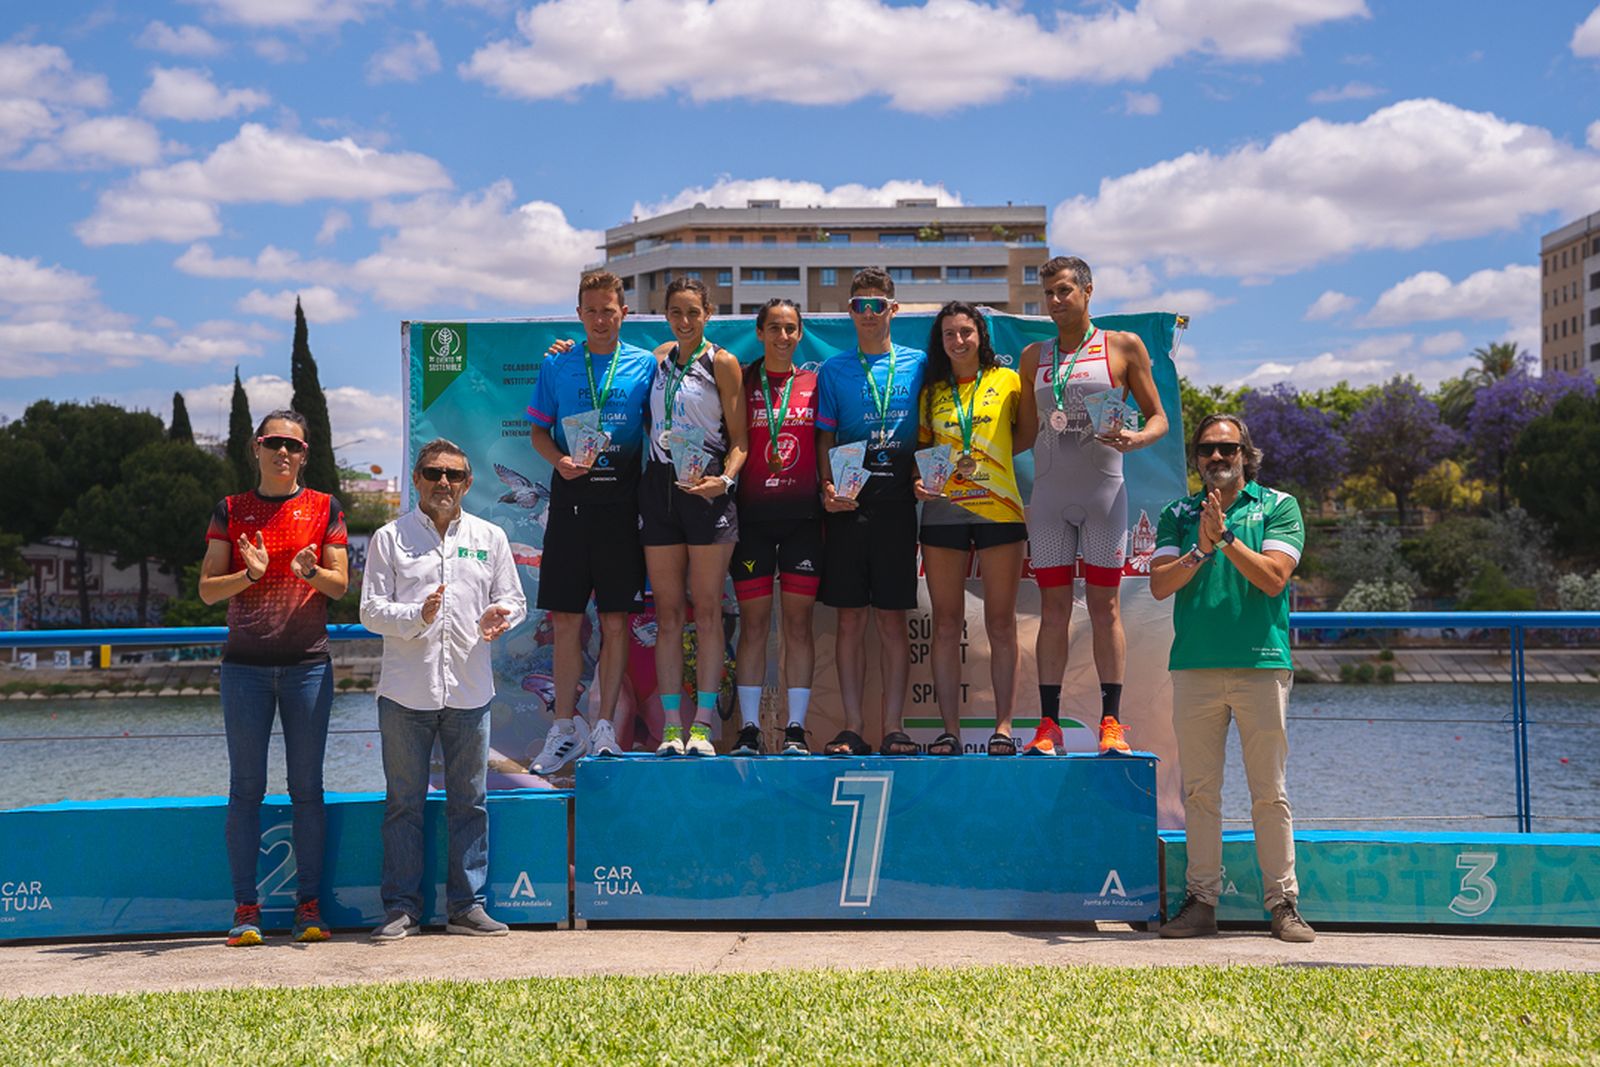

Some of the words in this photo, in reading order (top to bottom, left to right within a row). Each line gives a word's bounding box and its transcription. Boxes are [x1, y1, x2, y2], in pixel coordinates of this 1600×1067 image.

[831, 770, 895, 908] 1
[592, 865, 633, 880] CAR
[1, 881, 42, 896] CAR
[593, 880, 643, 896] TUJA
[1448, 852, 1498, 917] 3
[1, 896, 53, 912] TUJA
